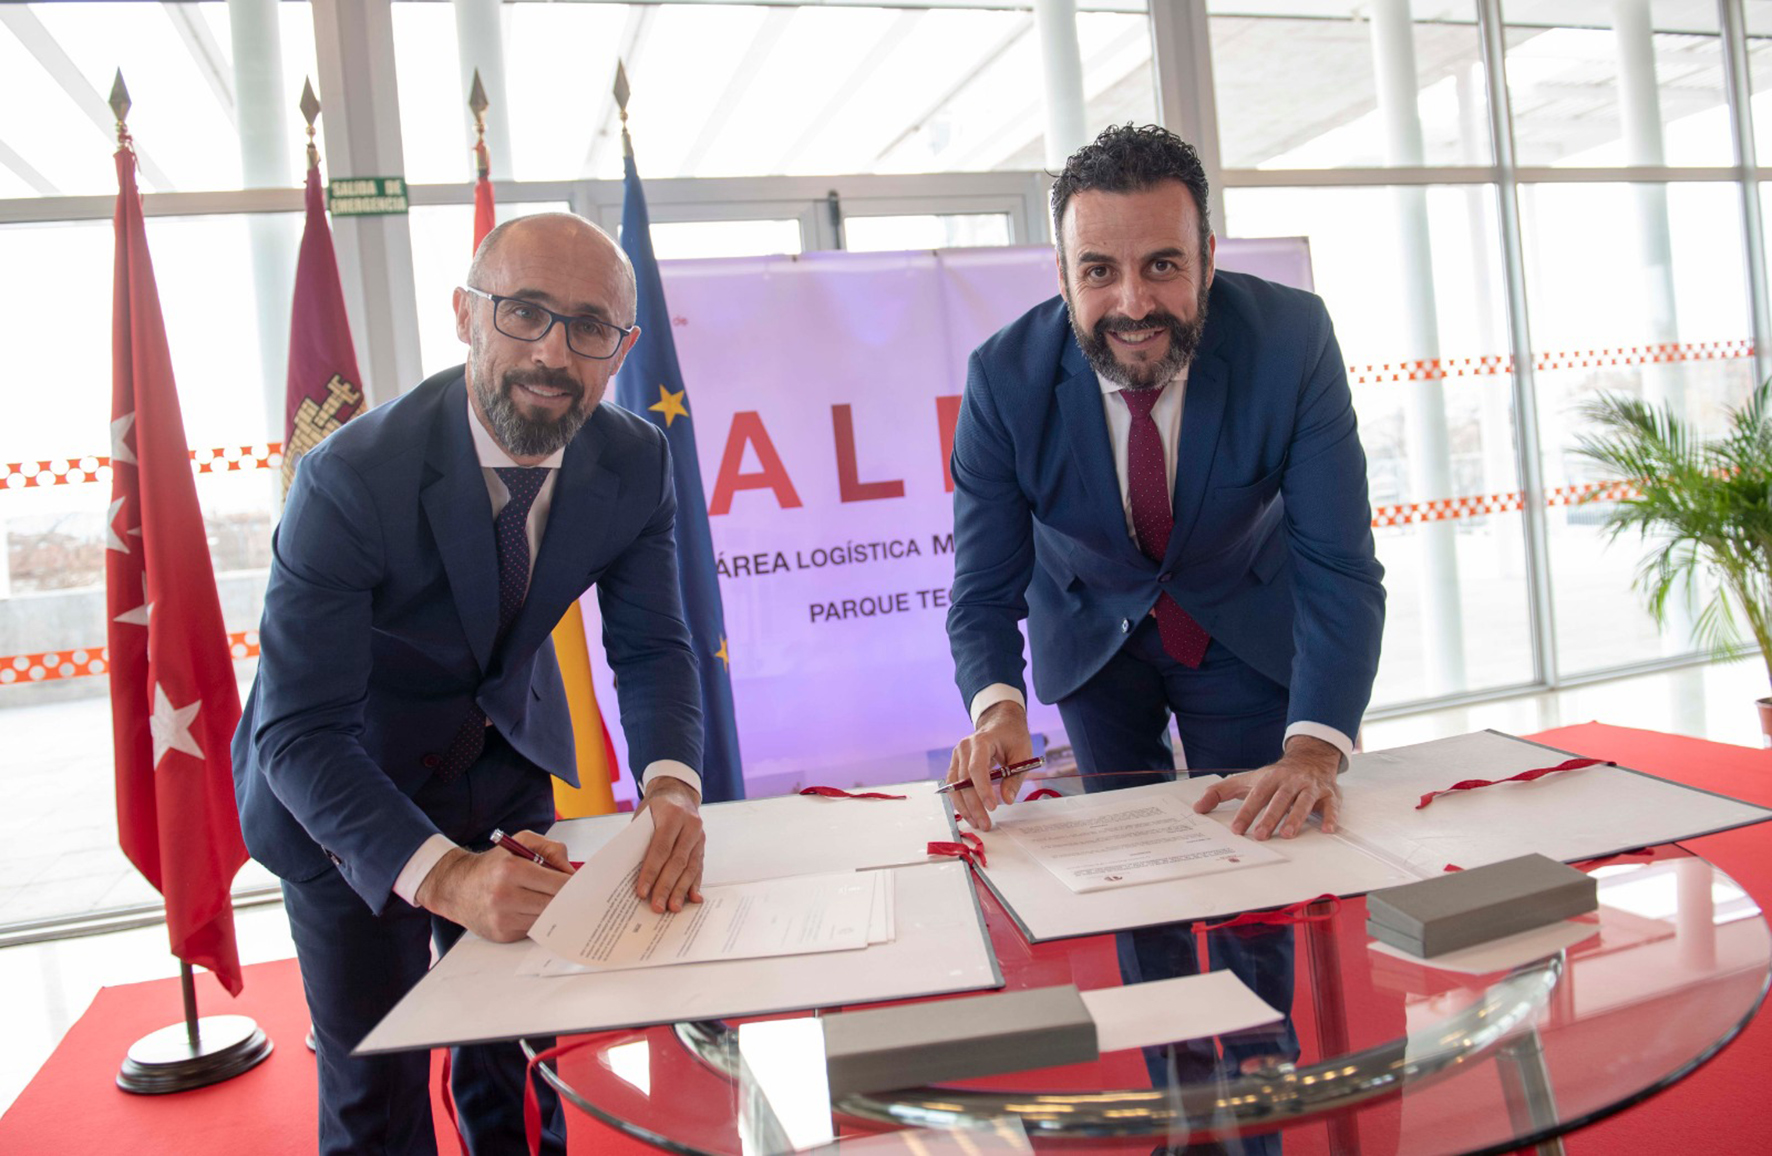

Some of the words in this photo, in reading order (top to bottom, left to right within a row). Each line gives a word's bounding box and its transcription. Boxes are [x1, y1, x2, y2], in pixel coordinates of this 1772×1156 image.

[332, 180, 378, 196] SALIDA
[384, 179, 402, 195] DE
[330, 196, 407, 215] EMERGENCIA
[717, 551, 791, 578] ÁREA
[797, 539, 921, 569] LOGÍSTICA
[809, 592, 910, 623] PARQUE
[916, 588, 953, 609] TE
